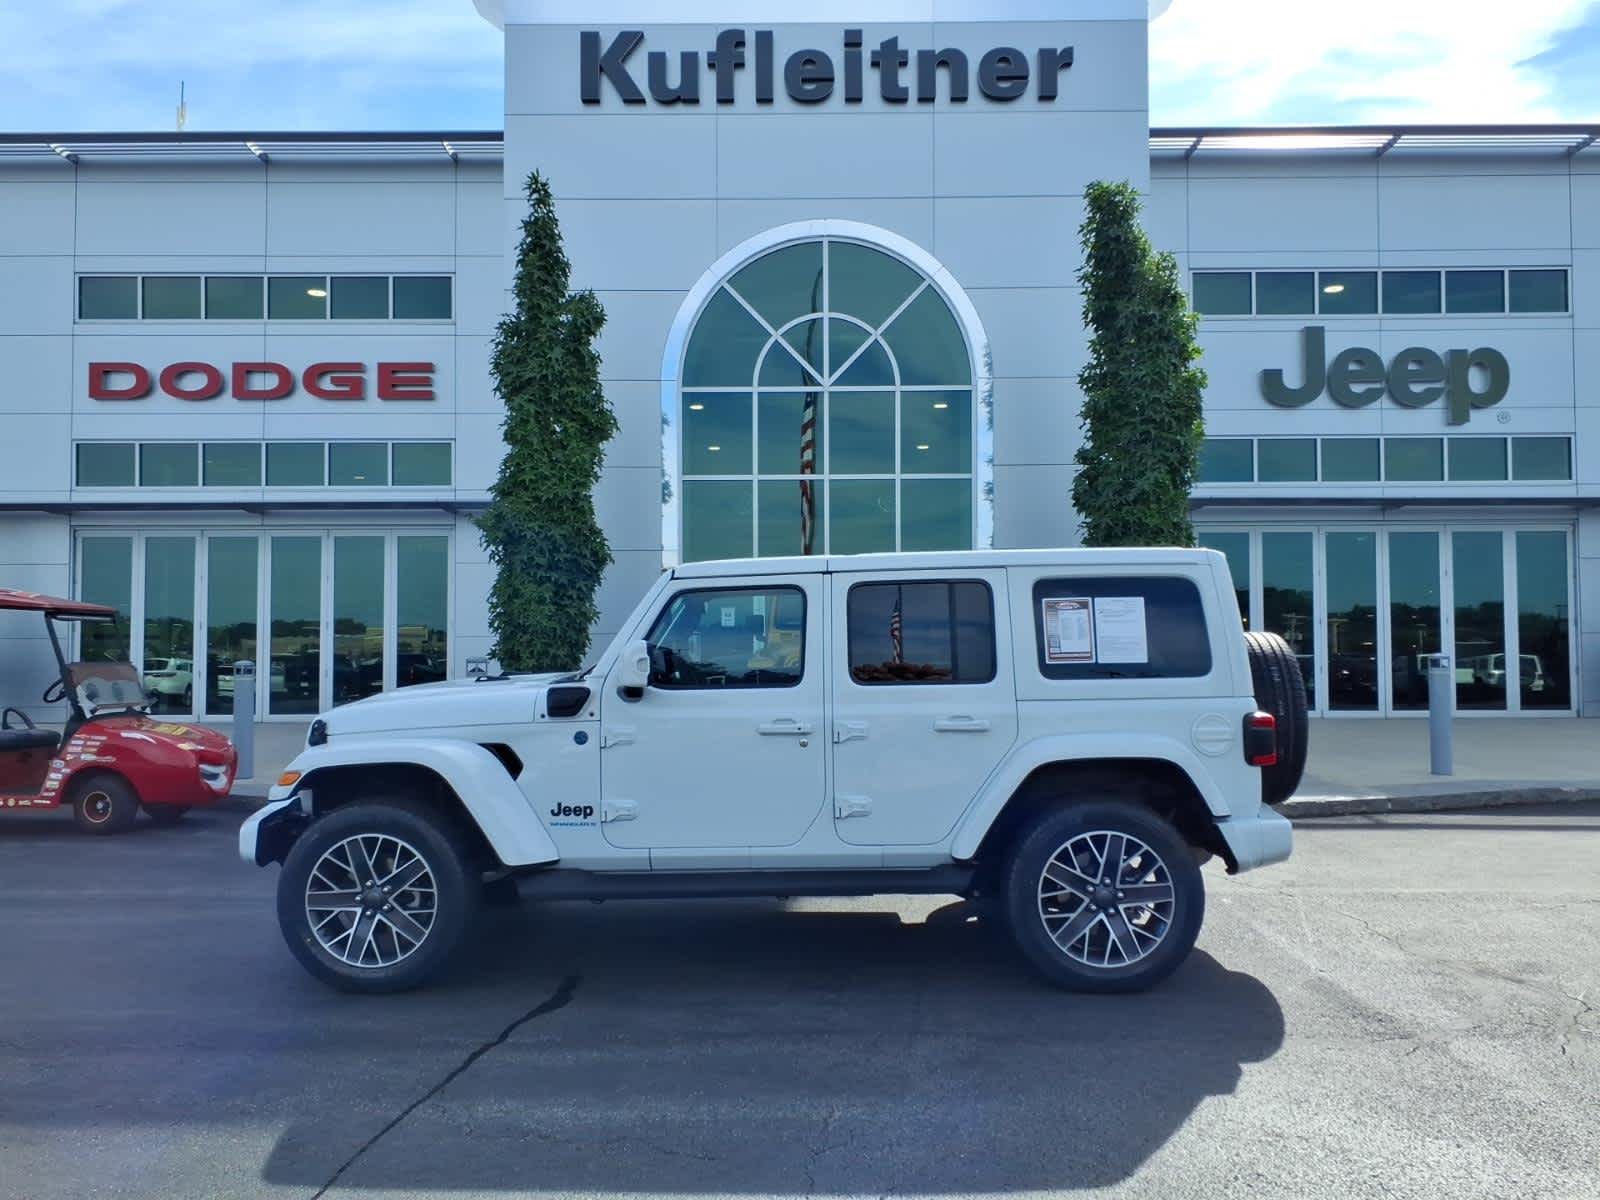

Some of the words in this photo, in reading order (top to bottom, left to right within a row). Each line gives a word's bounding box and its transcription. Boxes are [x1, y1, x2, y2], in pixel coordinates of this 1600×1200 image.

[579, 28, 1075, 105] Kufleitner
[88, 361, 436, 402] DODGE
[1259, 325, 1511, 426] Jeep
[550, 801, 594, 820] Jeep
